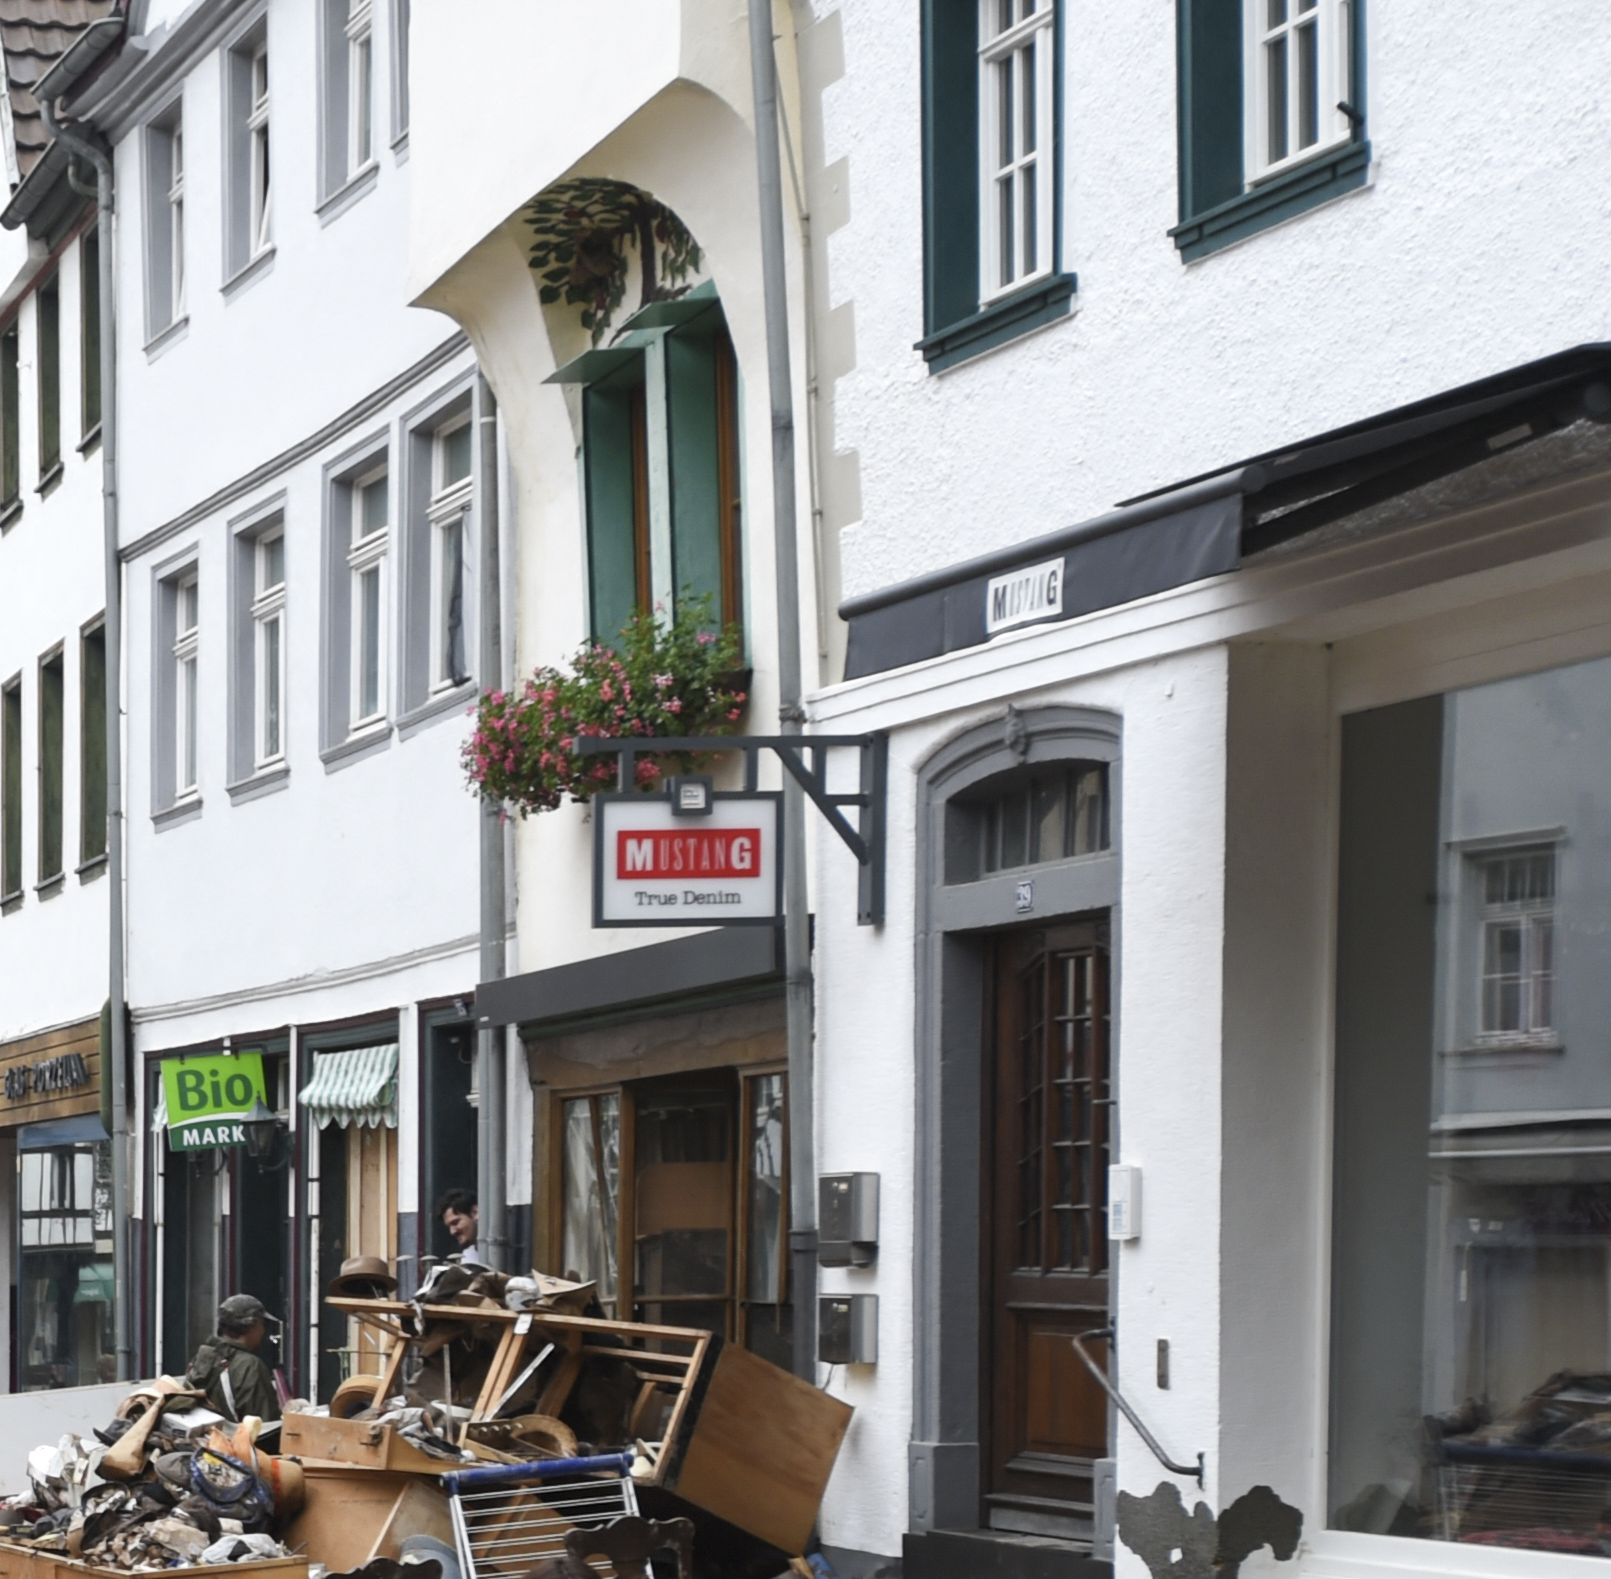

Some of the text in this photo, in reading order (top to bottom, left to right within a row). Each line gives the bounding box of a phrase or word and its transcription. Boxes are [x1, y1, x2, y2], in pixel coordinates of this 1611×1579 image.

[993, 569, 1058, 622] MUSTANG
[625, 836, 753, 872] MUSTANG
[635, 890, 742, 906] True Denim
[176, 1068, 254, 1112] Bio
[182, 1124, 246, 1147] MARK
